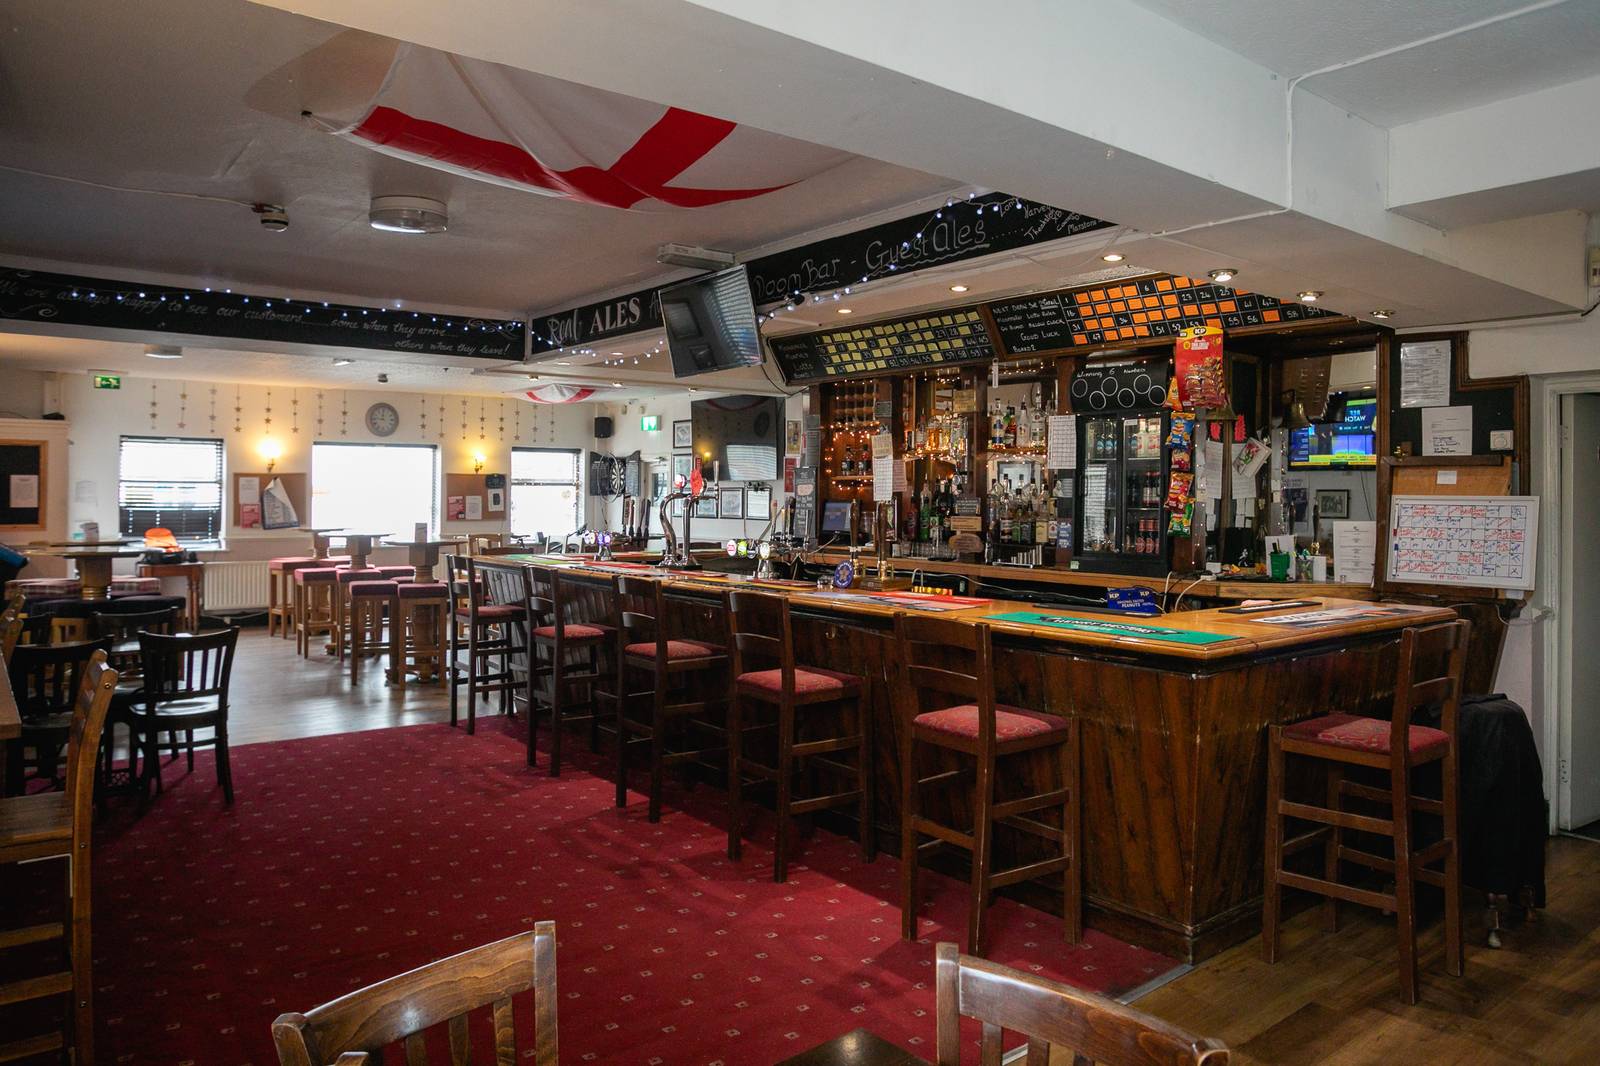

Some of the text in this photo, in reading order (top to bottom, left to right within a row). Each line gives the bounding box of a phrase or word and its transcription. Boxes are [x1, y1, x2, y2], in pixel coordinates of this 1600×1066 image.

[802, 258, 841, 286] Bar
[865, 240, 929, 271] Guest
[1182, 293, 1192, 301] 23
[168, 299, 183, 312] to
[186, 304, 209, 314] see
[216, 306, 241, 316] our
[590, 297, 640, 335] ALES
[1228, 317, 1239, 325] 55
[1247, 315, 1258, 323] 56
[1287, 310, 1298, 318] 58
[330, 319, 360, 329] some
[363, 319, 389, 332] when
[393, 321, 417, 339] they
[974, 324, 984, 332] 30
[1194, 327, 1206, 335] KP
[457, 343, 476, 356] they
[1109, 367, 1115, 375] 6
